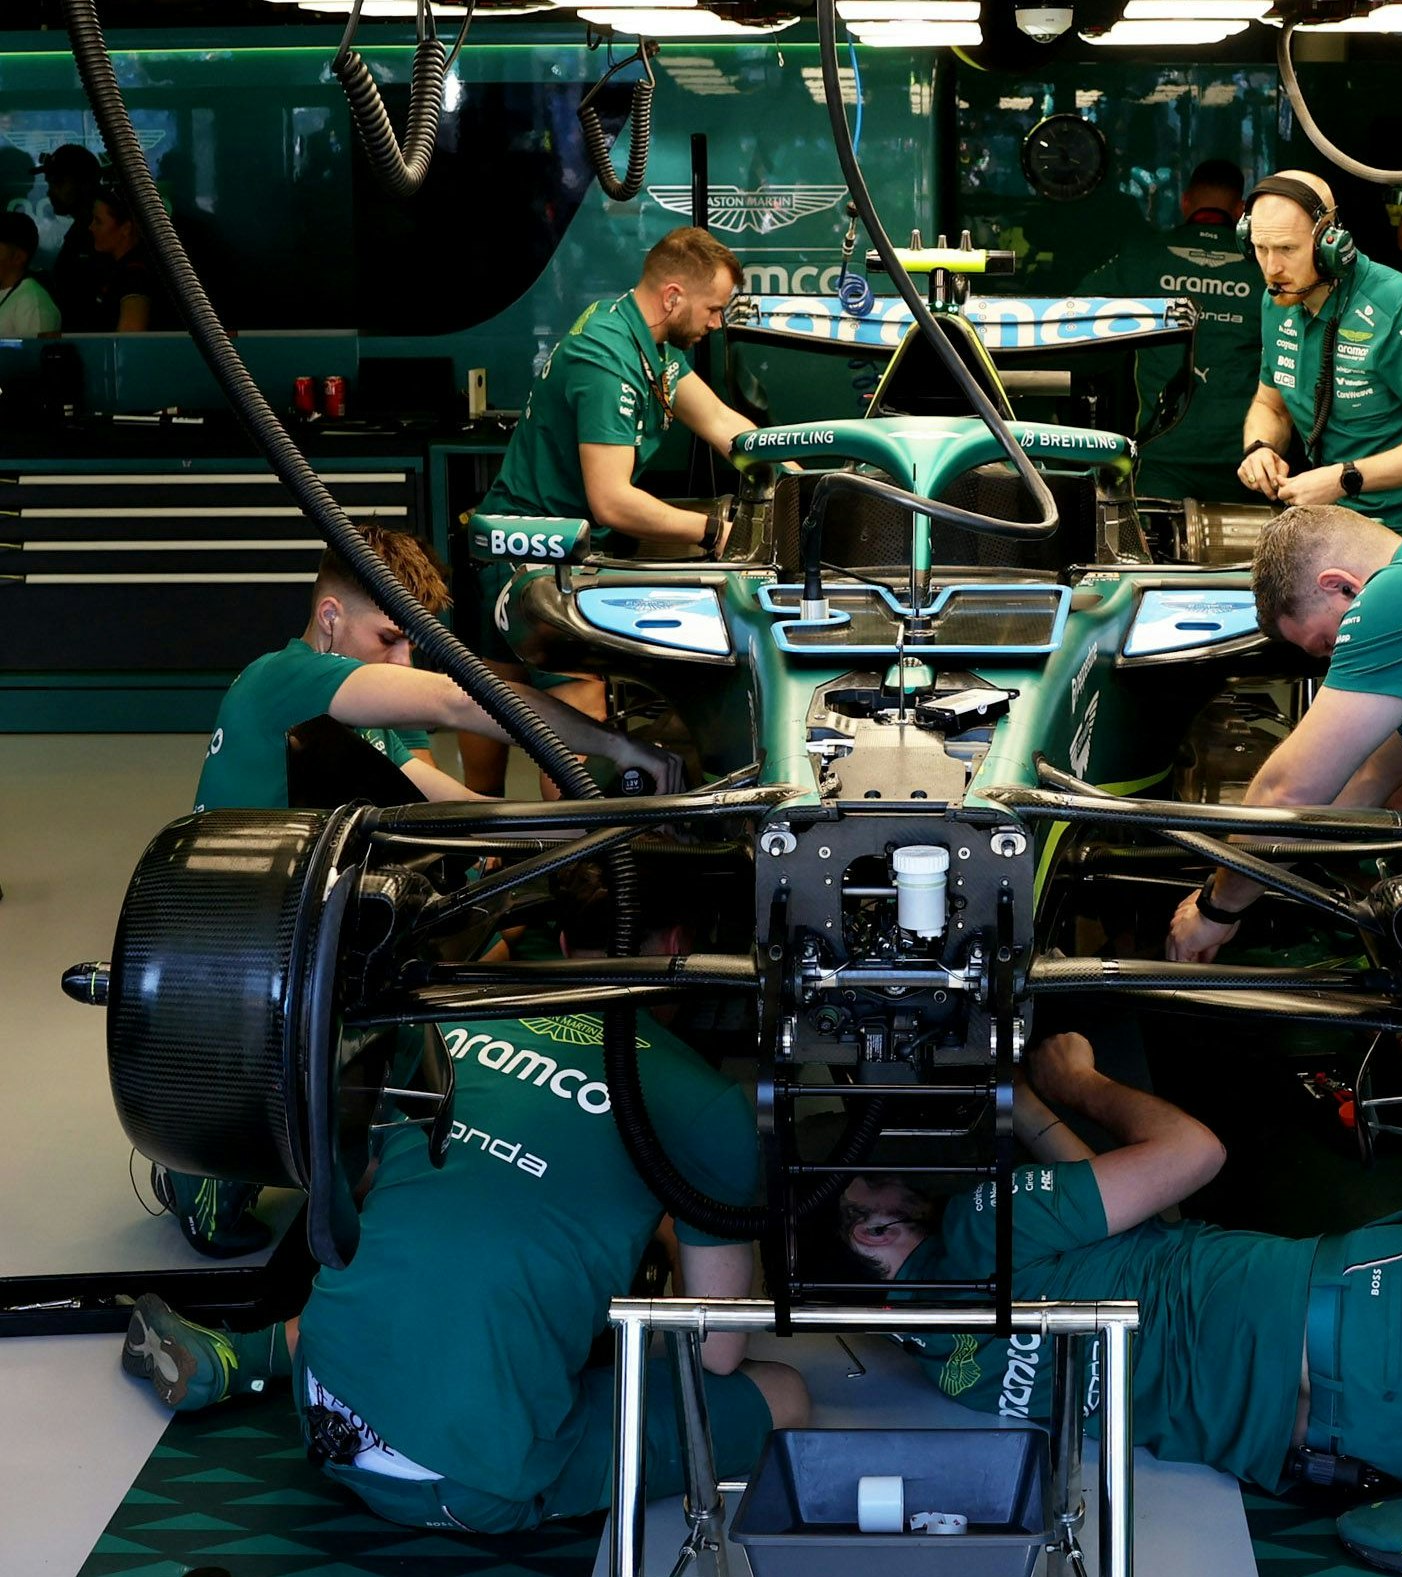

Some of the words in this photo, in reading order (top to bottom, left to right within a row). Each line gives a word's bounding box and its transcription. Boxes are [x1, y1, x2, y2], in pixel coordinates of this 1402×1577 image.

[708, 196, 744, 207] ASTON
[747, 196, 792, 207] MARTIN
[1160, 274, 1251, 298] aramco
[1199, 311, 1243, 324] onda
[758, 431, 834, 447] BREITLING
[1039, 433, 1117, 450] BREITLING
[490, 530, 566, 559] BOSS
[561, 1015, 600, 1036] MARTIN
[451, 1119, 548, 1178] onda
[1371, 1267, 1381, 1297] BOSS
[998, 1333, 1042, 1418] ramco
